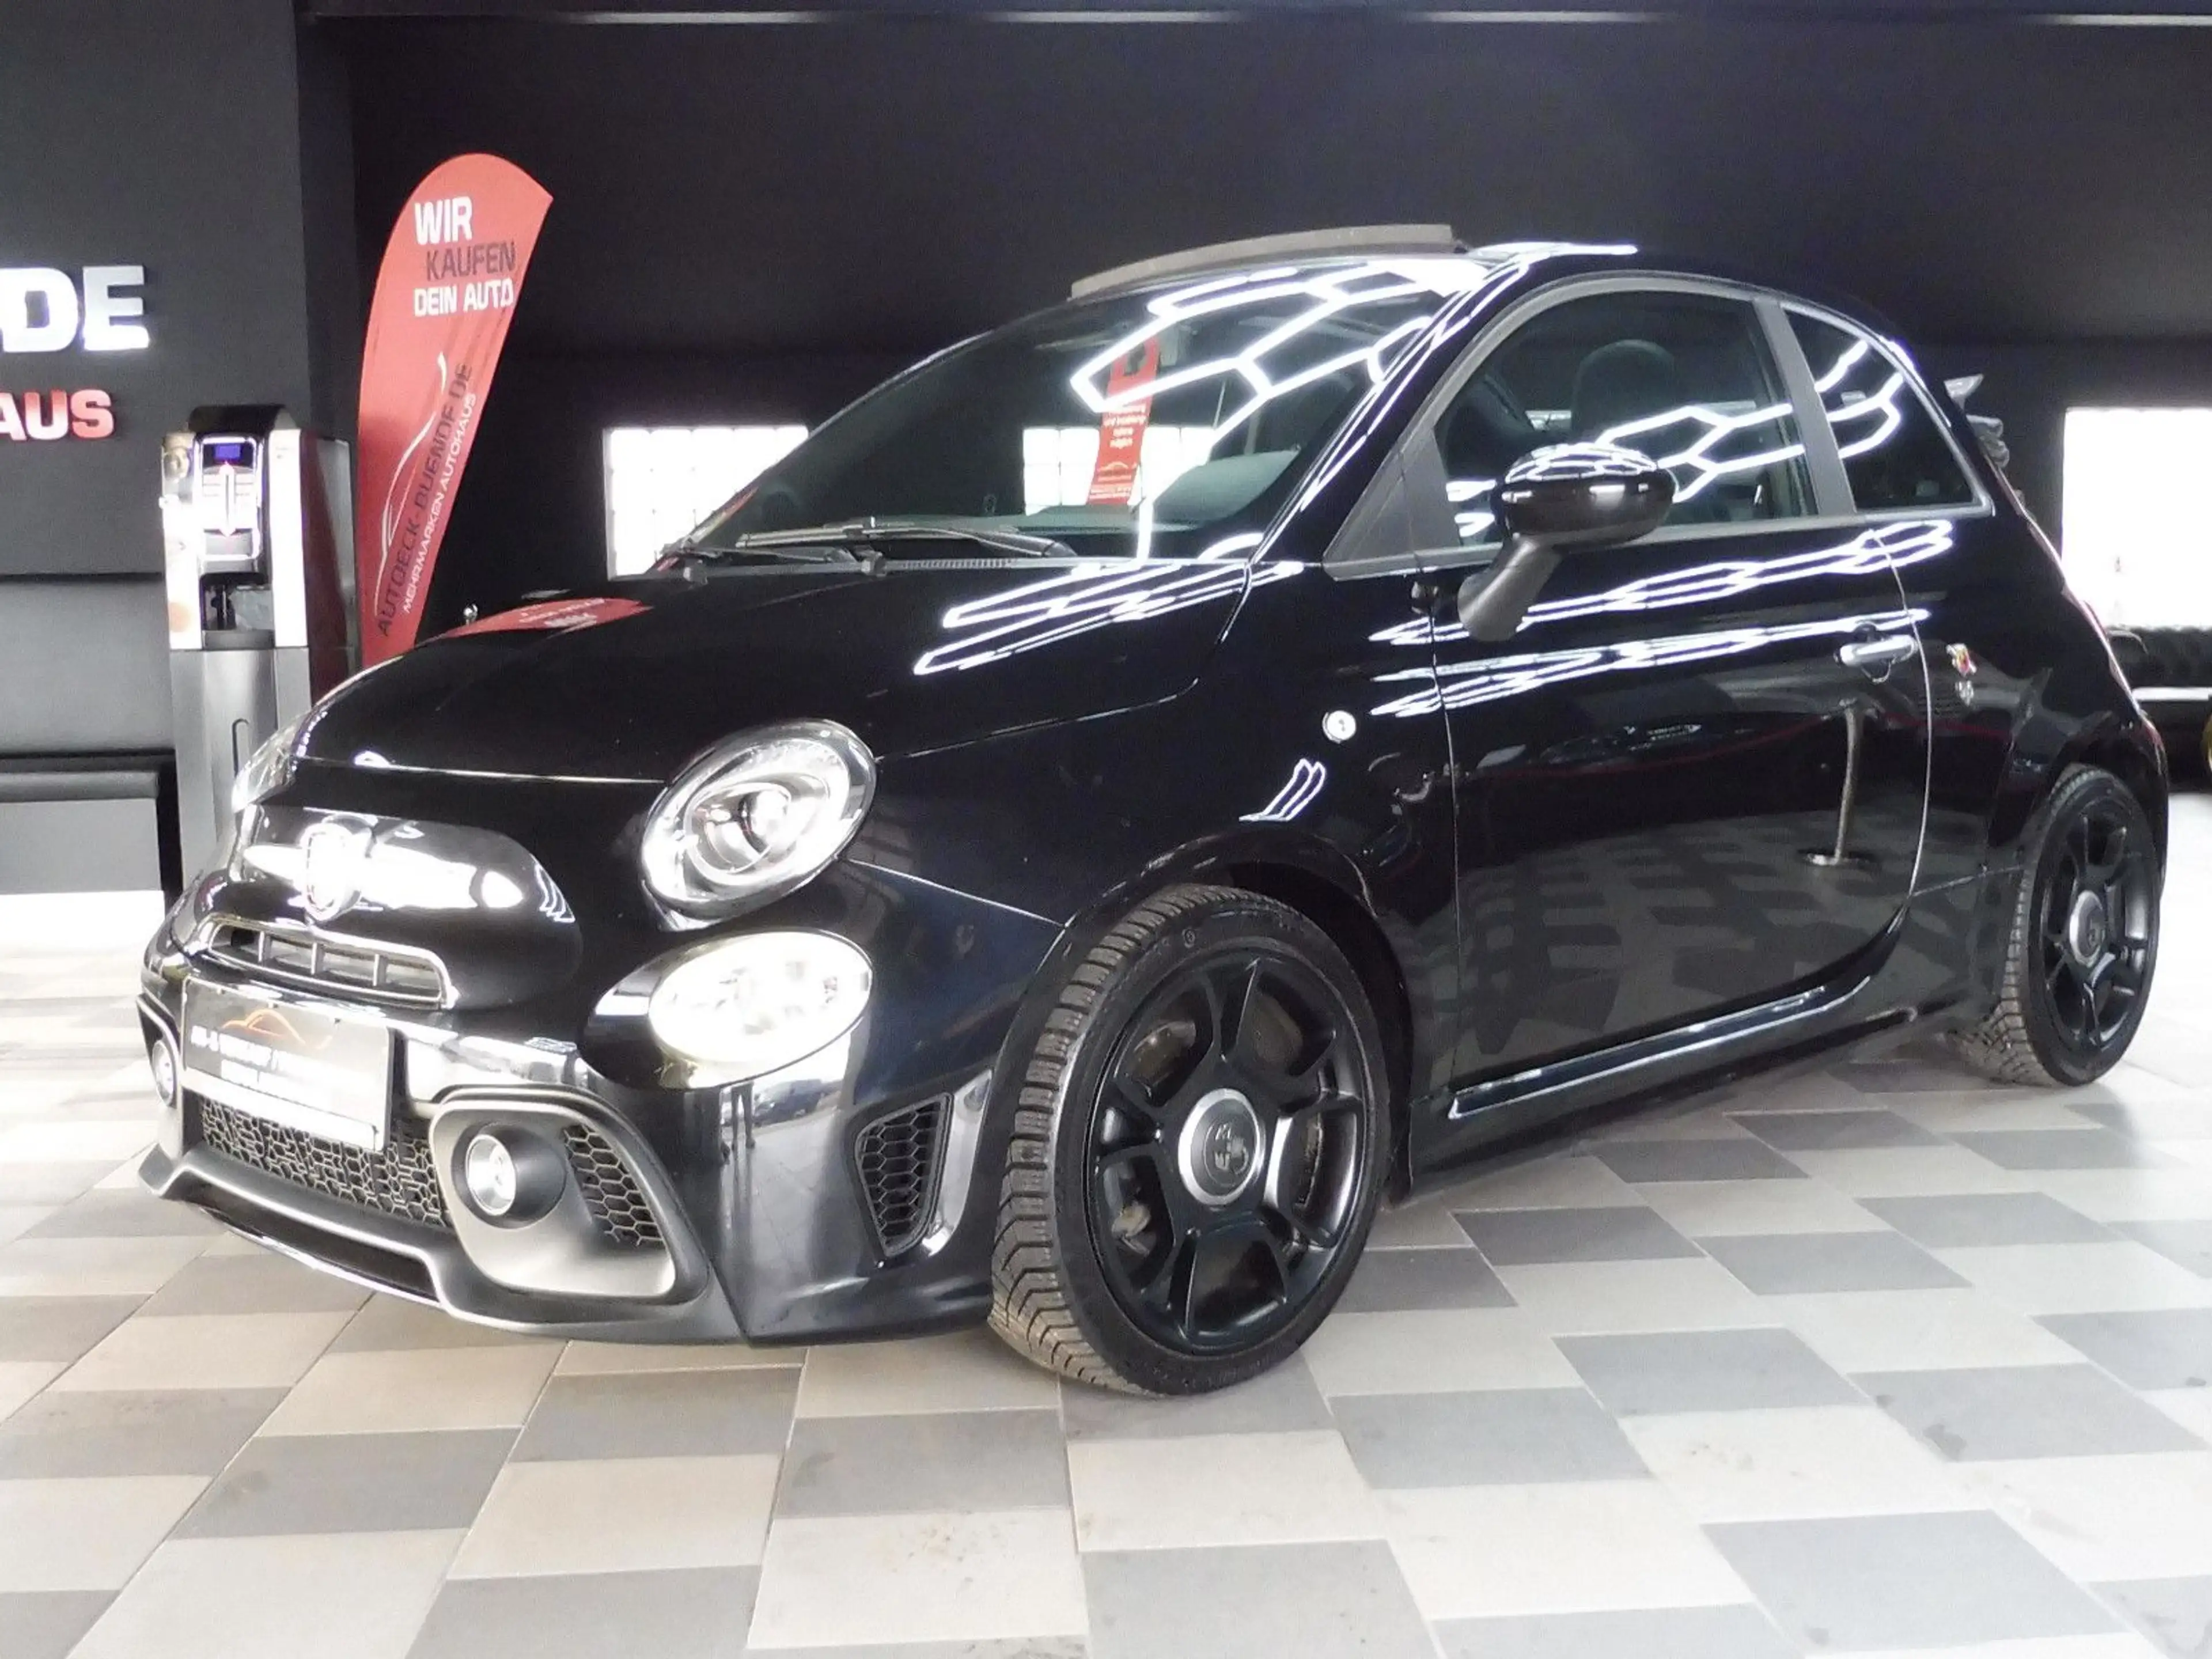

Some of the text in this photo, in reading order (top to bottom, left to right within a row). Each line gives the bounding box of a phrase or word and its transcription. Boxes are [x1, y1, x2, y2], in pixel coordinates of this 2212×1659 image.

[414, 196, 472, 245] WIR
[426, 241, 517, 282] KAUFEN
[414, 277, 514, 317] DEIN AUTO
[403, 393, 476, 614] MEHRMARKEN AUTOHAUS
